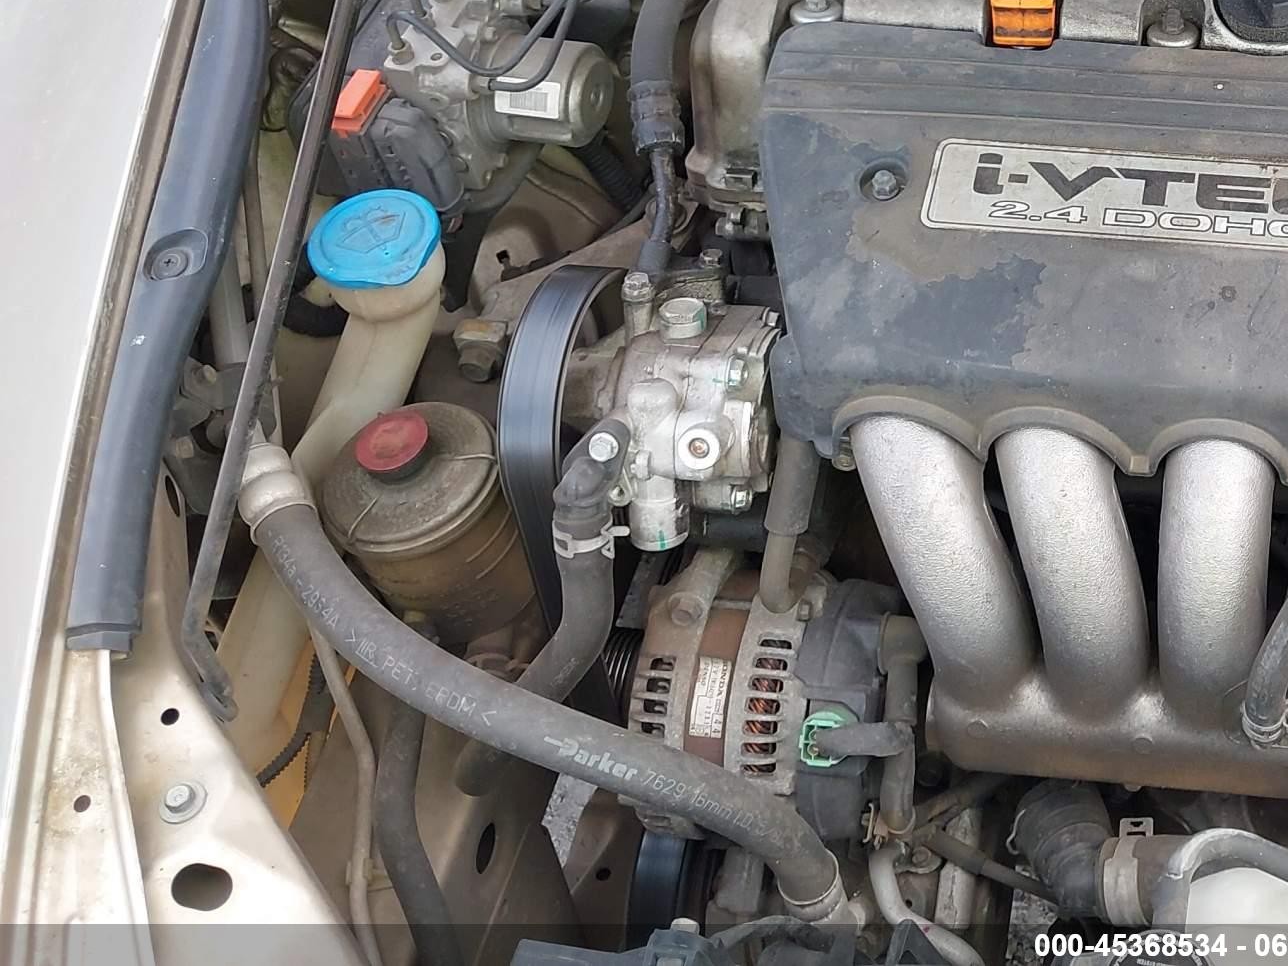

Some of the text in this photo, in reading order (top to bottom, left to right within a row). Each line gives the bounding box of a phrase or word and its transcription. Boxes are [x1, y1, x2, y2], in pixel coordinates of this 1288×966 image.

[988, 200, 1088, 224] 2.4
[271, 536, 298, 579] R134a
[545, 736, 638, 781] Parker
[642, 771, 686, 800] 7629
[691, 788, 733, 820] 16mm
